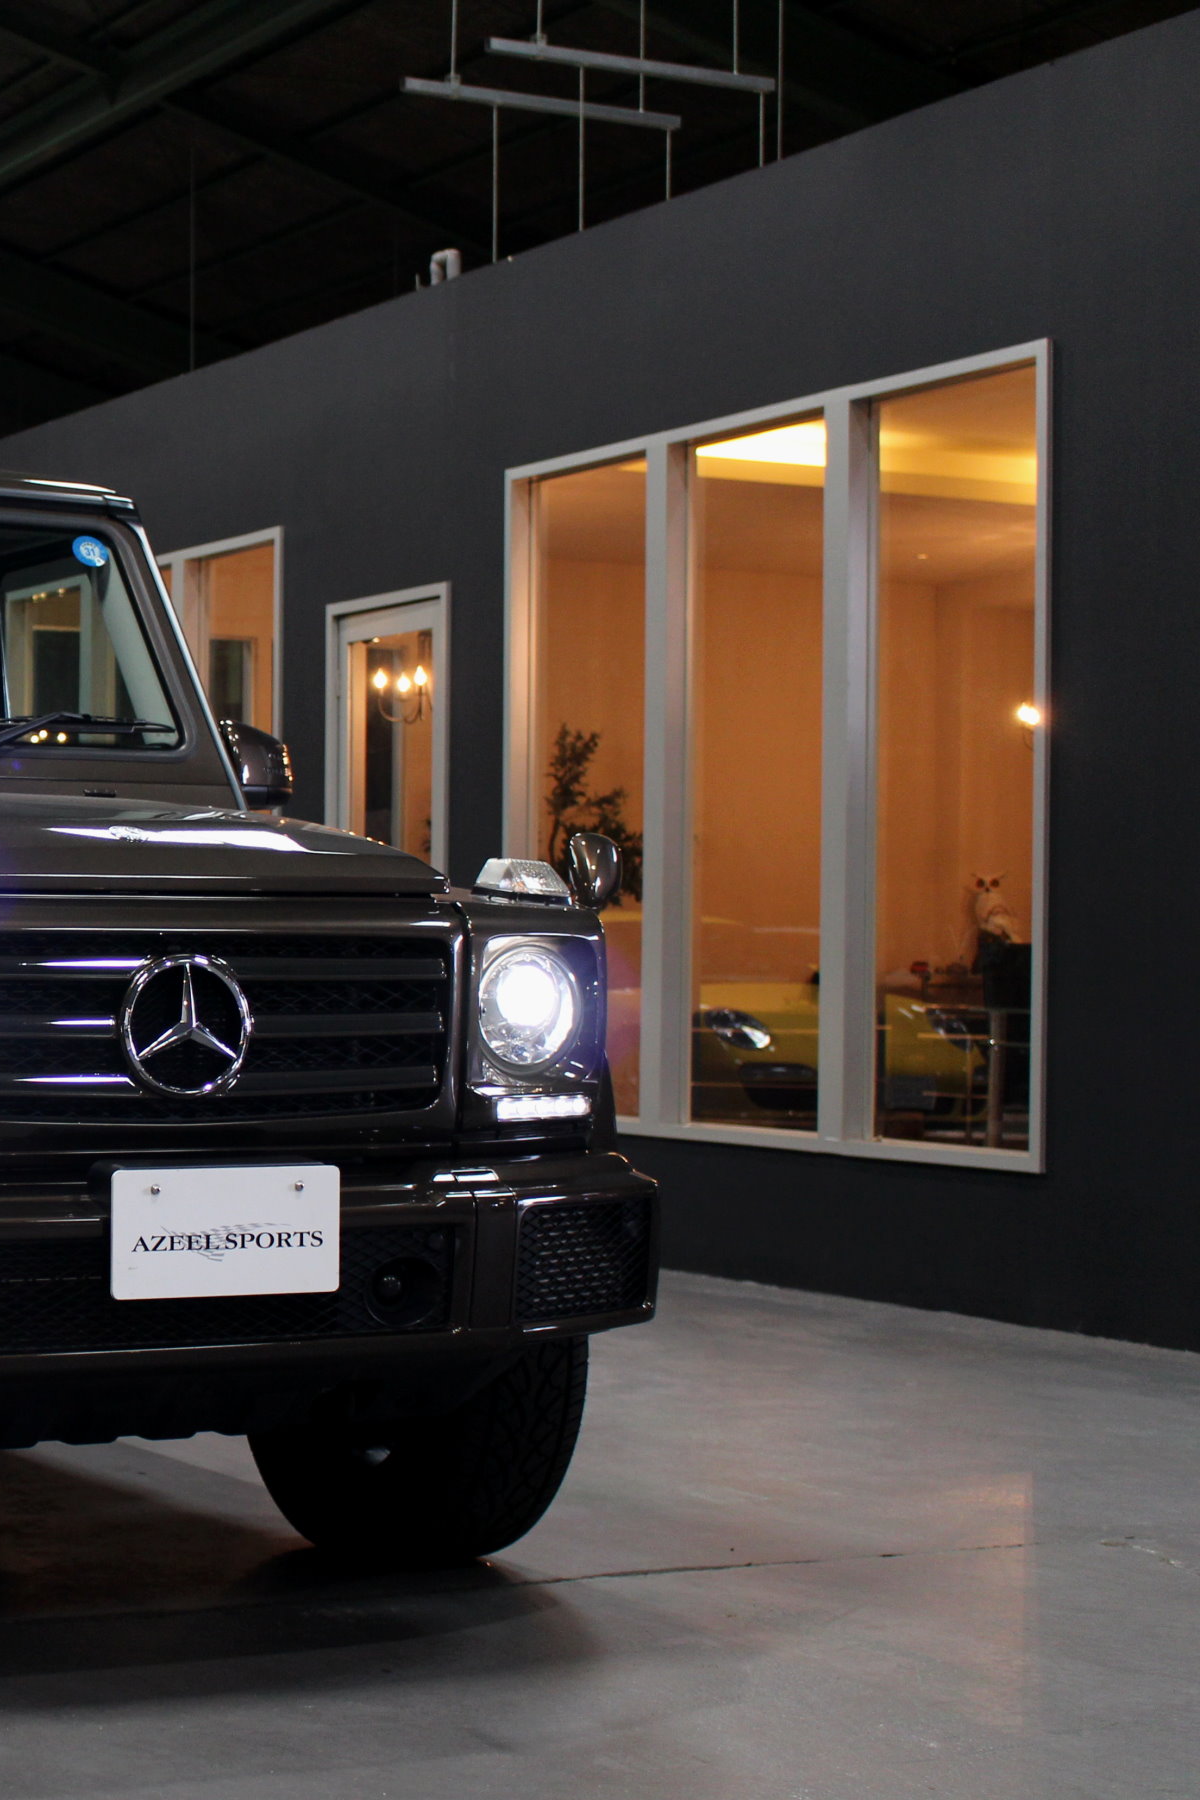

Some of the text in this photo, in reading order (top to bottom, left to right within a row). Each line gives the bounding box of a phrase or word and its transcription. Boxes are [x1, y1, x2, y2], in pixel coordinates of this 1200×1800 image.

[84, 547, 96, 557] 31
[131, 1230, 324, 1252] AZEEL SPORTS
